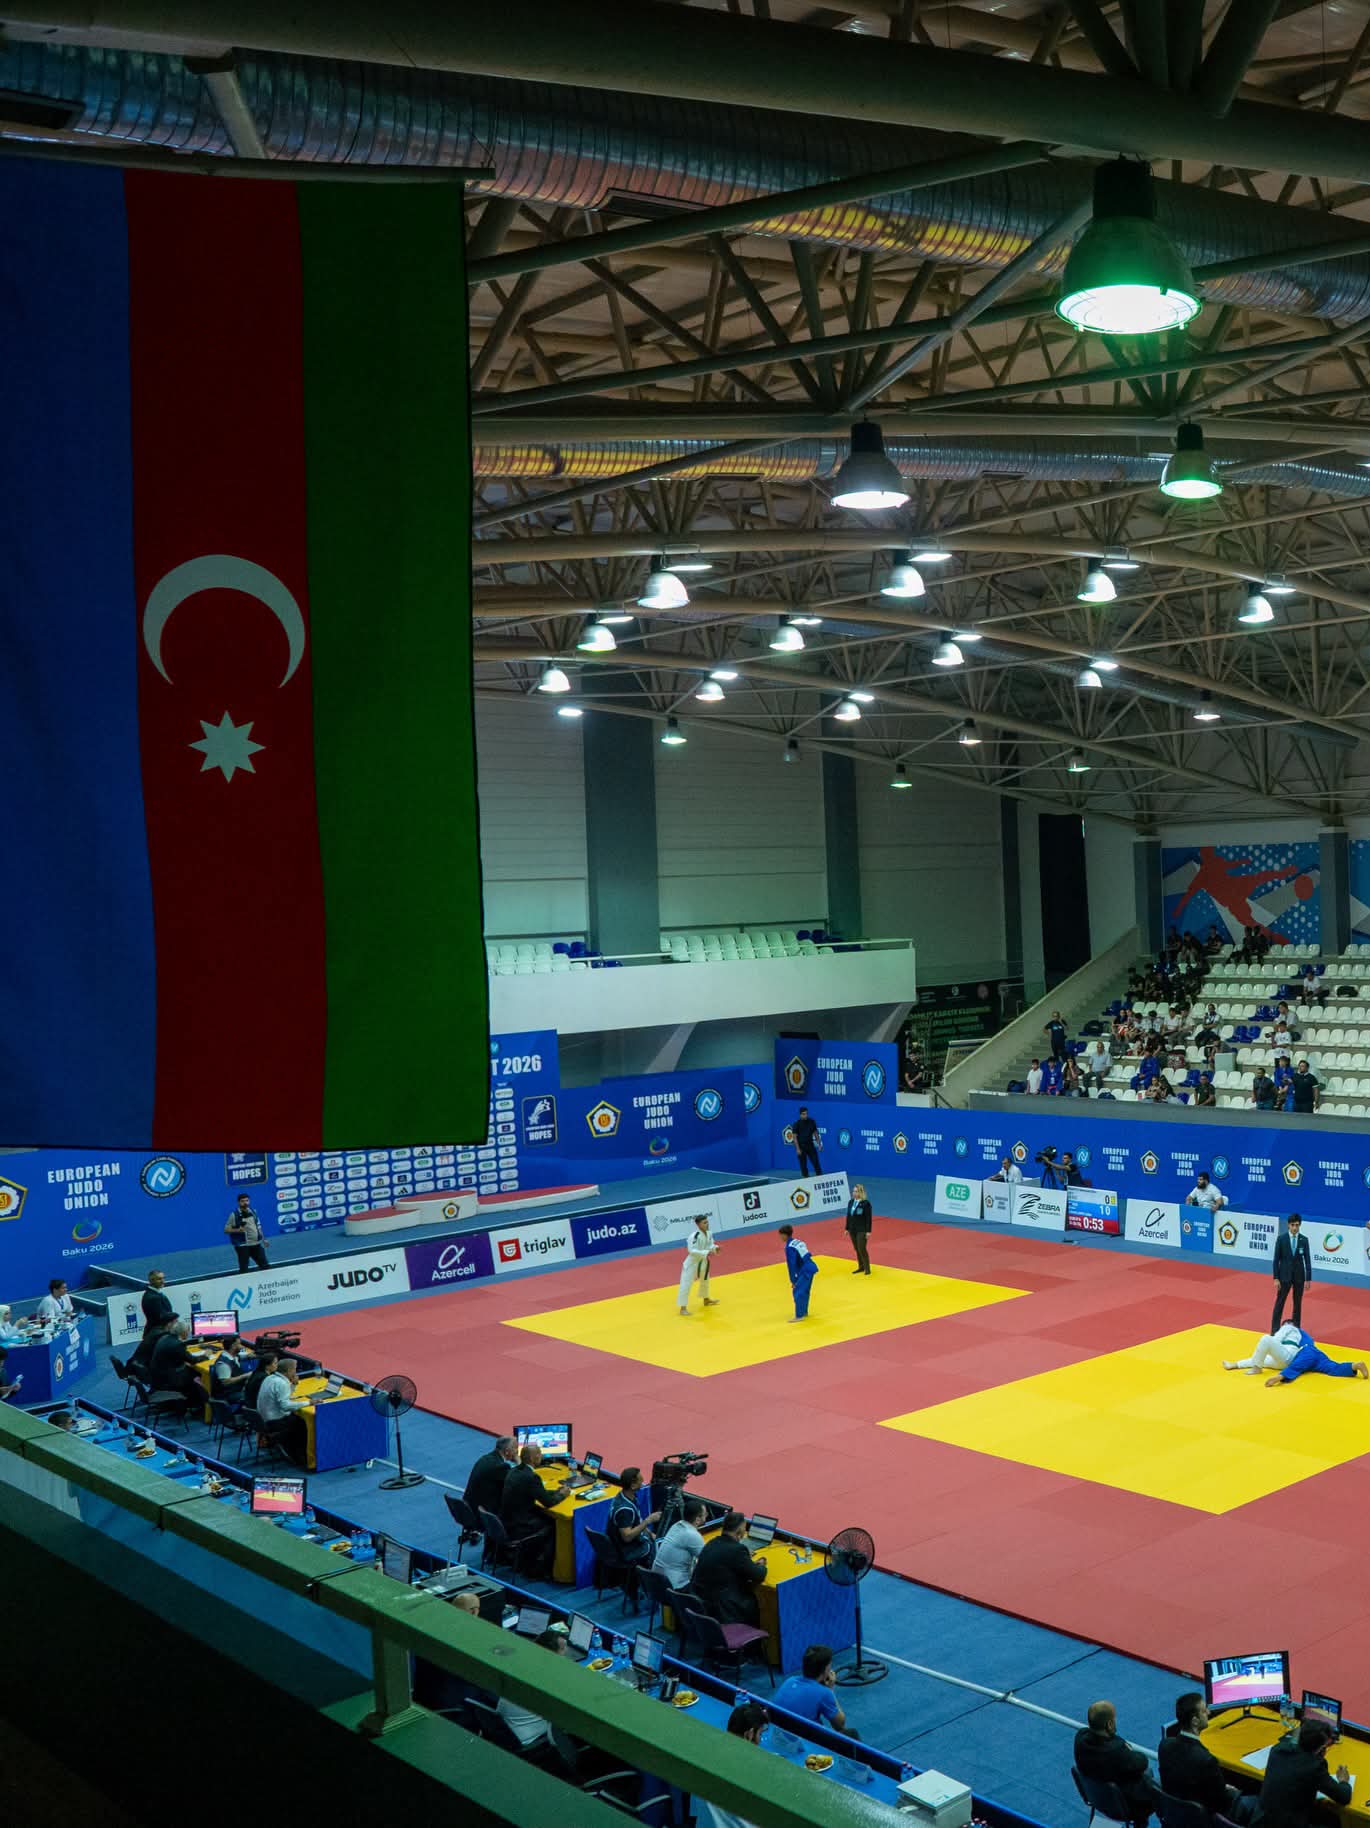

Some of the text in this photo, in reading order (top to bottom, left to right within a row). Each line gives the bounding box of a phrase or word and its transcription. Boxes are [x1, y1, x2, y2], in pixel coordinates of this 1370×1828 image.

[502, 1055, 542, 1075] 2026
[817, 1058, 852, 1071] EUROPEAN
[827, 1071, 843, 1082] JUDO
[824, 1083, 846, 1096] UNION
[633, 1092, 680, 1107] EUROPEAN
[646, 1105, 669, 1118] JUDO
[644, 1116, 673, 1129] UNION
[529, 1130, 552, 1141] HOPES
[48, 1163, 120, 1183] EUROPEAN
[233, 1168, 261, 1180] HOPES
[68, 1179, 103, 1195] JUDO
[949, 1186, 966, 1198] AZE
[64, 1193, 108, 1210] UNION
[1105, 1195, 1110, 1204] 0
[1038, 1203, 1060, 1211] ZEBRA
[743, 1212, 768, 1224] judoaz
[1083, 1217, 1104, 1230] 0:53
[587, 1222, 637, 1244] judo.az
[1138, 1227, 1168, 1239] Azercell
[1244, 1222, 1274, 1233] EUROPEAN
[1252, 1232, 1266, 1241] JUDO
[62, 1242, 114, 1256] Baku 2026
[523, 1235, 566, 1255] triglav
[1249, 1241, 1268, 1250] UNION
[1314, 1254, 1349, 1265] Baku 2026
[431, 1263, 475, 1282] Azercell
[258, 1278, 298, 1291] Azerbaijan
[259, 1289, 277, 1298] Judo
[259, 1293, 300, 1305] Federation
